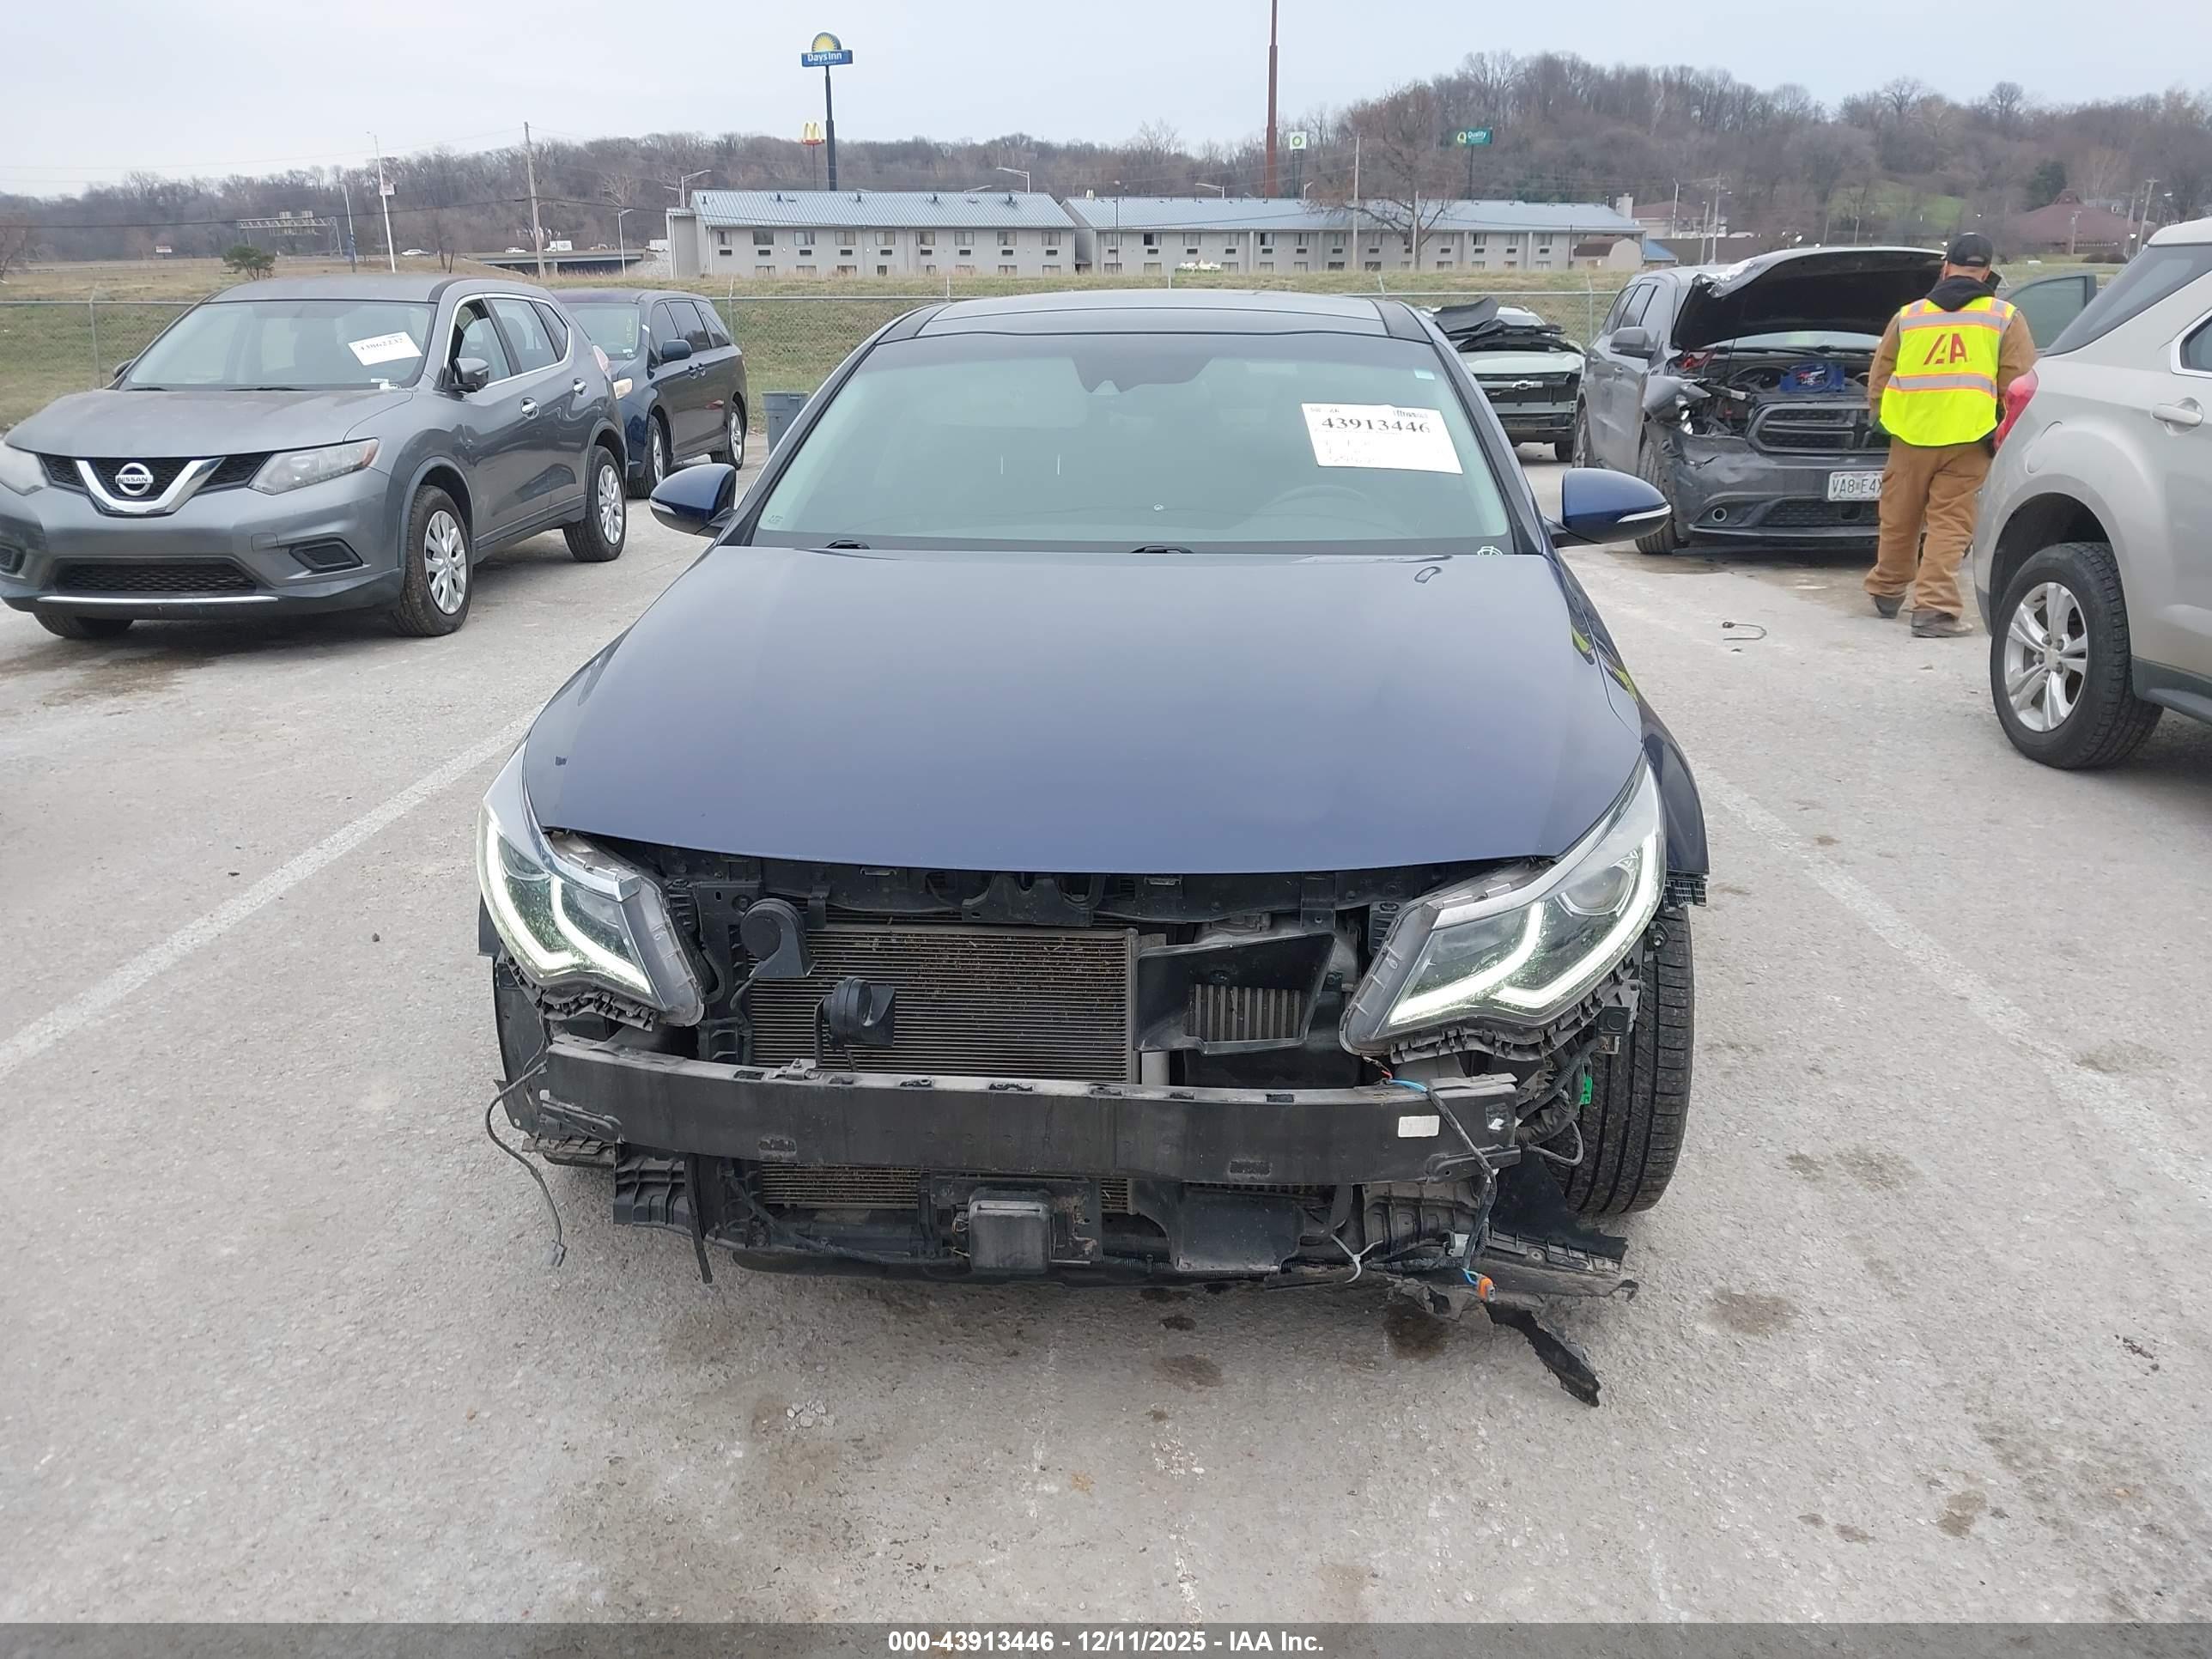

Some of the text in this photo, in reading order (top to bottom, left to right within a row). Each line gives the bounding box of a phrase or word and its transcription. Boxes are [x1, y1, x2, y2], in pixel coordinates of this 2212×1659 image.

[807, 52, 842, 63] Days Inn
[1468, 130, 1487, 140] Quality
[1321, 416, 1431, 434] 43913446
[1832, 477, 1856, 495] VA8
